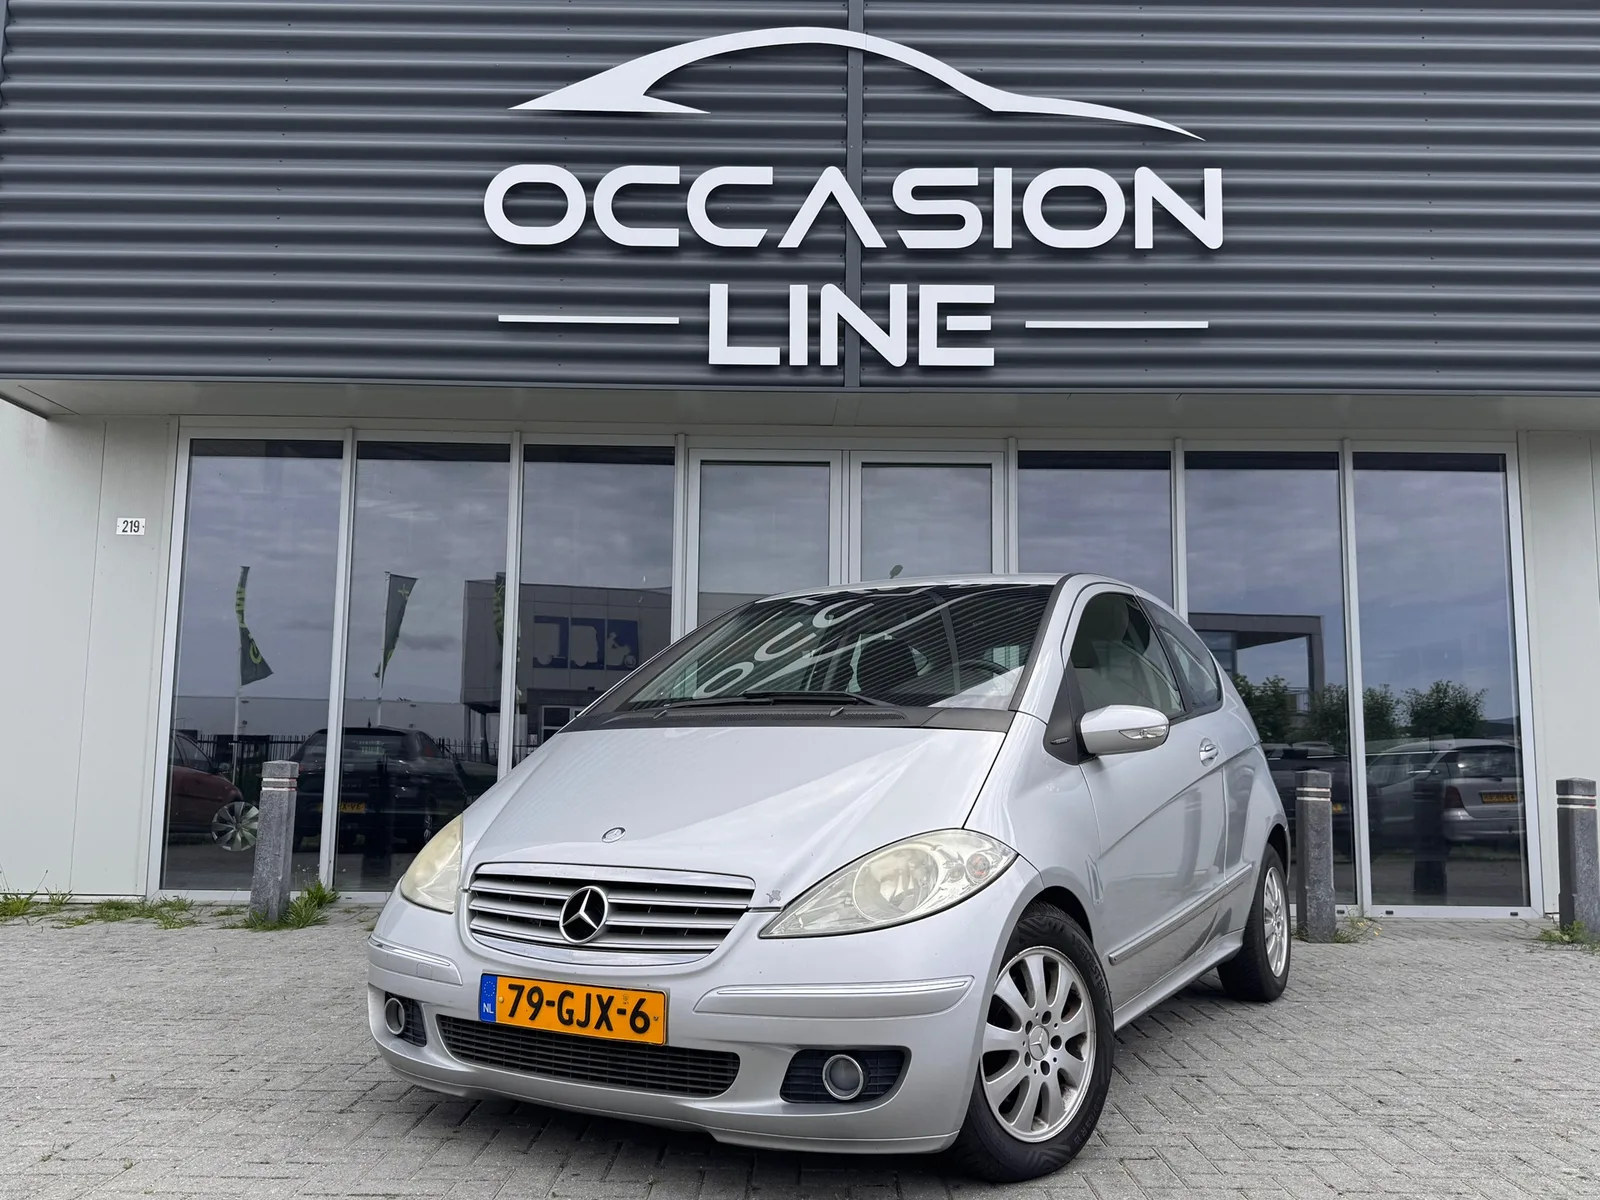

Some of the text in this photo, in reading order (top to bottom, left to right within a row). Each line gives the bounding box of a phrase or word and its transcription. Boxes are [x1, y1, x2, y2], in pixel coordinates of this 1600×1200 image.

[483, 164, 1224, 249] OCCASION
[708, 283, 996, 367] LINE
[122, 520, 140, 533] 219
[482, 1002, 495, 1014] NL
[508, 983, 651, 1035] 79-GJX-6
